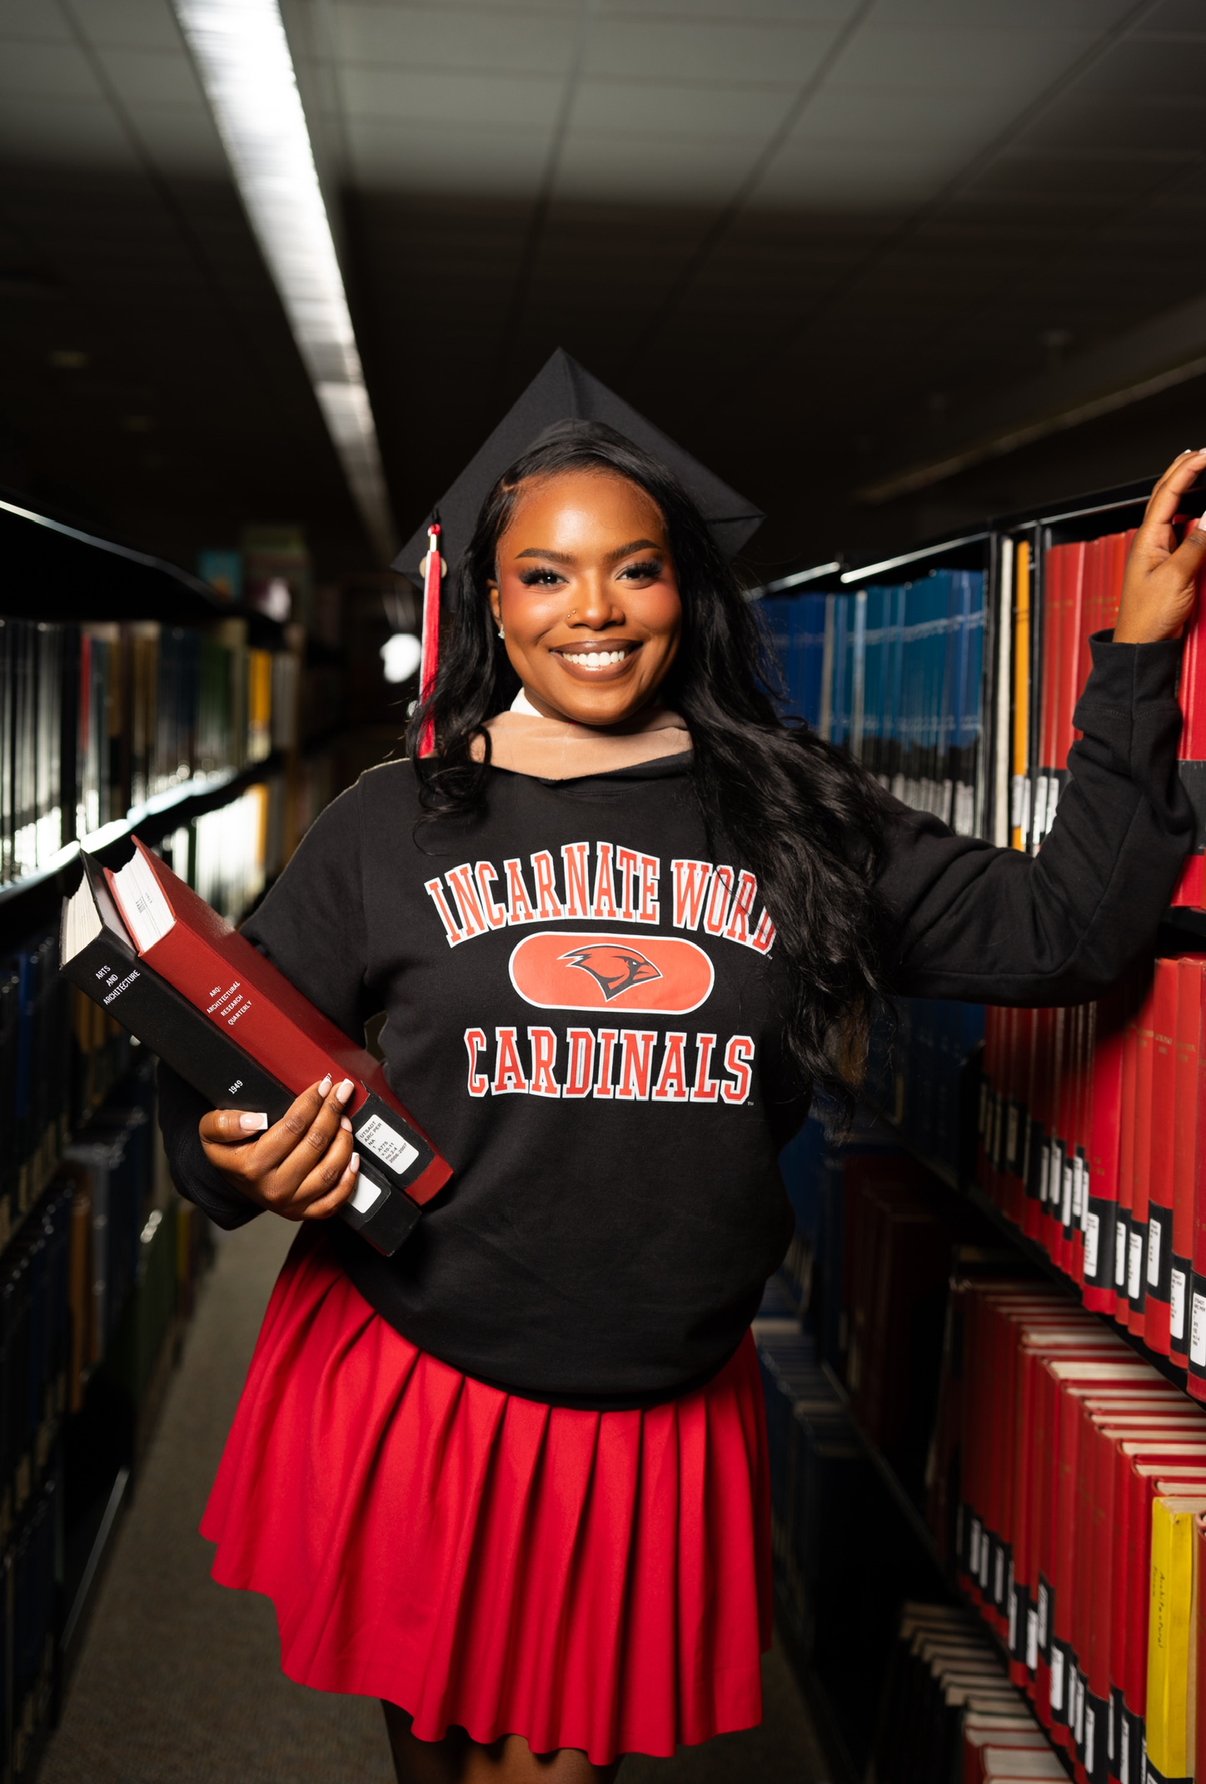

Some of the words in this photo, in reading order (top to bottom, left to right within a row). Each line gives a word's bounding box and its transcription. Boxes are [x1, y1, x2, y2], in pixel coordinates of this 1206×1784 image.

[424, 841, 660, 948] INCARNATE
[96, 965, 111, 980] ARTS
[105, 974, 119, 988] AND
[103, 969, 141, 1005] ARCHITECTURE
[207, 981, 241, 1014] ARCHITECTURAL
[209, 986, 222, 998] ARQ:
[220, 994, 244, 1016] RESEARCH
[227, 1000, 252, 1025] QUARTERLY
[464, 1026, 755, 1105] CARDINALS
[228, 1080, 243, 1094] 1949
[373, 1122, 382, 1133] PER
